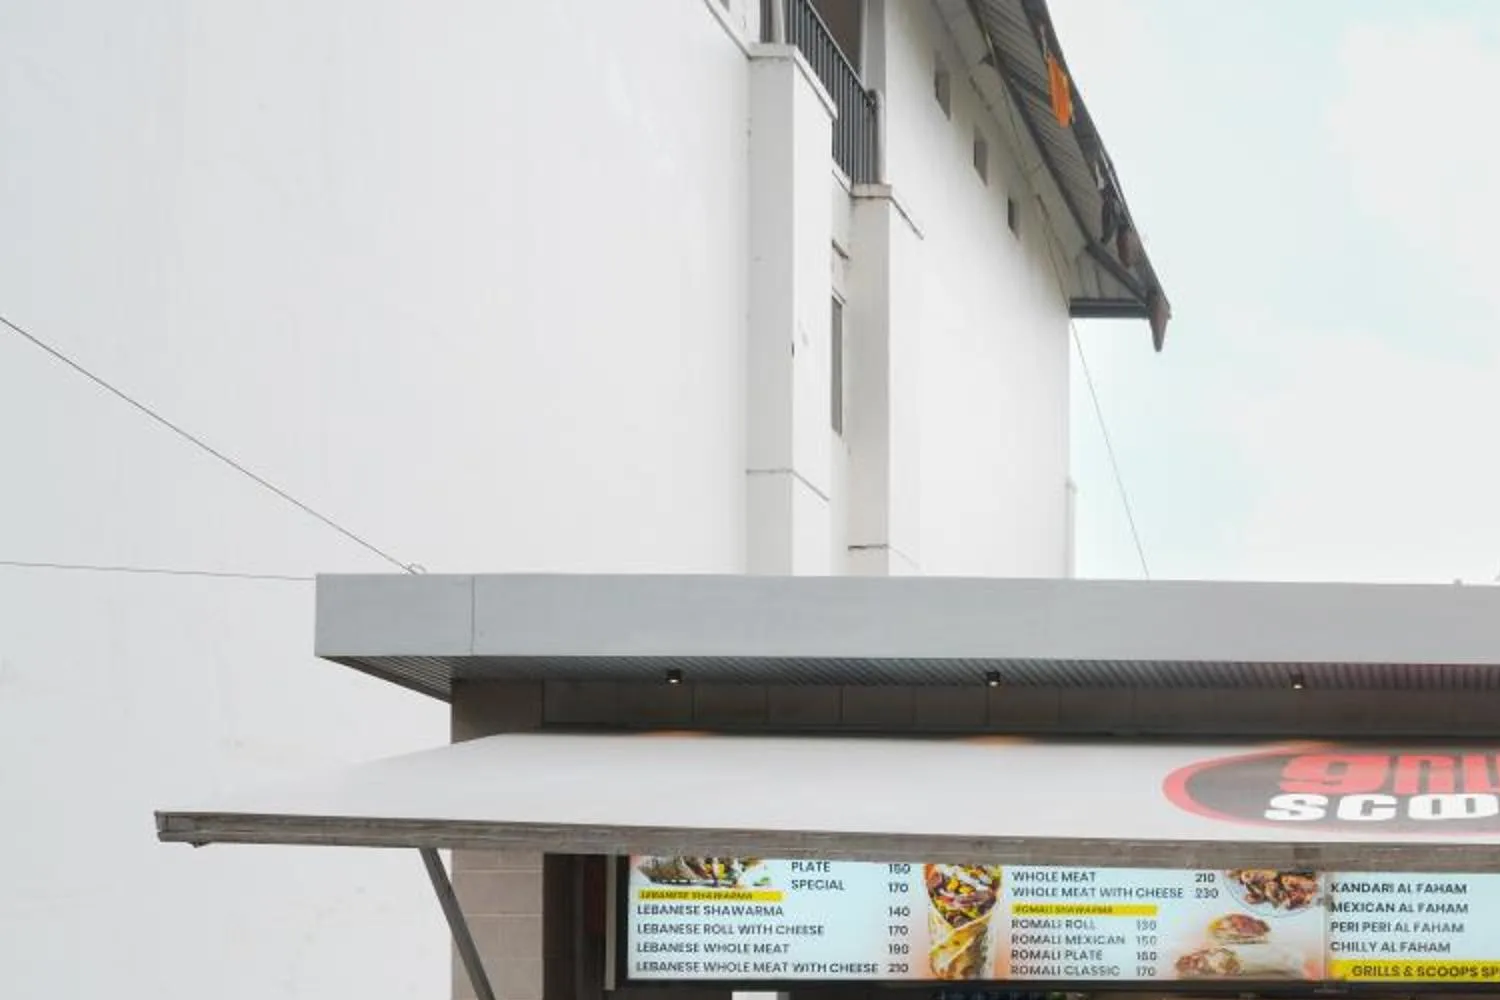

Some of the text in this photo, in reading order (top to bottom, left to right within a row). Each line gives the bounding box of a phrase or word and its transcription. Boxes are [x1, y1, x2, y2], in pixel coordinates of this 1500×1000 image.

[792, 862, 830, 872] PLATE
[1012, 872, 1216, 882] WHOLE MEAT 210
[791, 880, 910, 894] SPECIAL 170
[1330, 883, 1394, 894] KANDARI
[1398, 883, 1412, 894] AL
[1416, 883, 1467, 894] FAHAM
[1012, 888, 1218, 898] WHOLE MEAT WITH CHEESE 230
[636, 904, 910, 916] LEBANESE SHAWARMA 140
[1330, 902, 1395, 912] MEXICAN
[1398, 902, 1414, 912] AL
[1417, 902, 1468, 912] FAHAM
[1011, 919, 1061, 929] ROMALI
[1065, 919, 1096, 929] ROLL
[1330, 922, 1358, 932] PERI
[1362, 922, 1391, 932] PERI
[1394, 922, 1411, 932] AL
[1413, 922, 1464, 932] FAHAM
[636, 924, 909, 936] LEBANESE ROLL WITH CHEESE 170
[1011, 934, 1061, 944] ROMALI
[1064, 934, 1126, 944] MEXICAN
[636, 942, 700, 953] LEBANESE
[704, 942, 750, 954] WHOLE
[754, 943, 790, 954] MEAT
[1330, 942, 1378, 952] CHILLY
[1380, 942, 1398, 952] AL
[1400, 942, 1450, 952] FAHAM
[1010, 950, 1061, 960] ROMALI
[1064, 950, 1102, 960] PLATE
[636, 962, 700, 972] LEBANESE
[702, 962, 750, 972] WHOLE
[753, 962, 788, 972] MEAT
[792, 963, 826, 973] WITH
[830, 963, 878, 973] CHEESE
[1010, 965, 1061, 976] ROMALI
[1064, 965, 1120, 976] CLASSIC
[1352, 965, 1400, 976] GRILLS
[1403, 965, 1414, 976] &
[1417, 966, 1478, 978] SCOOPS
